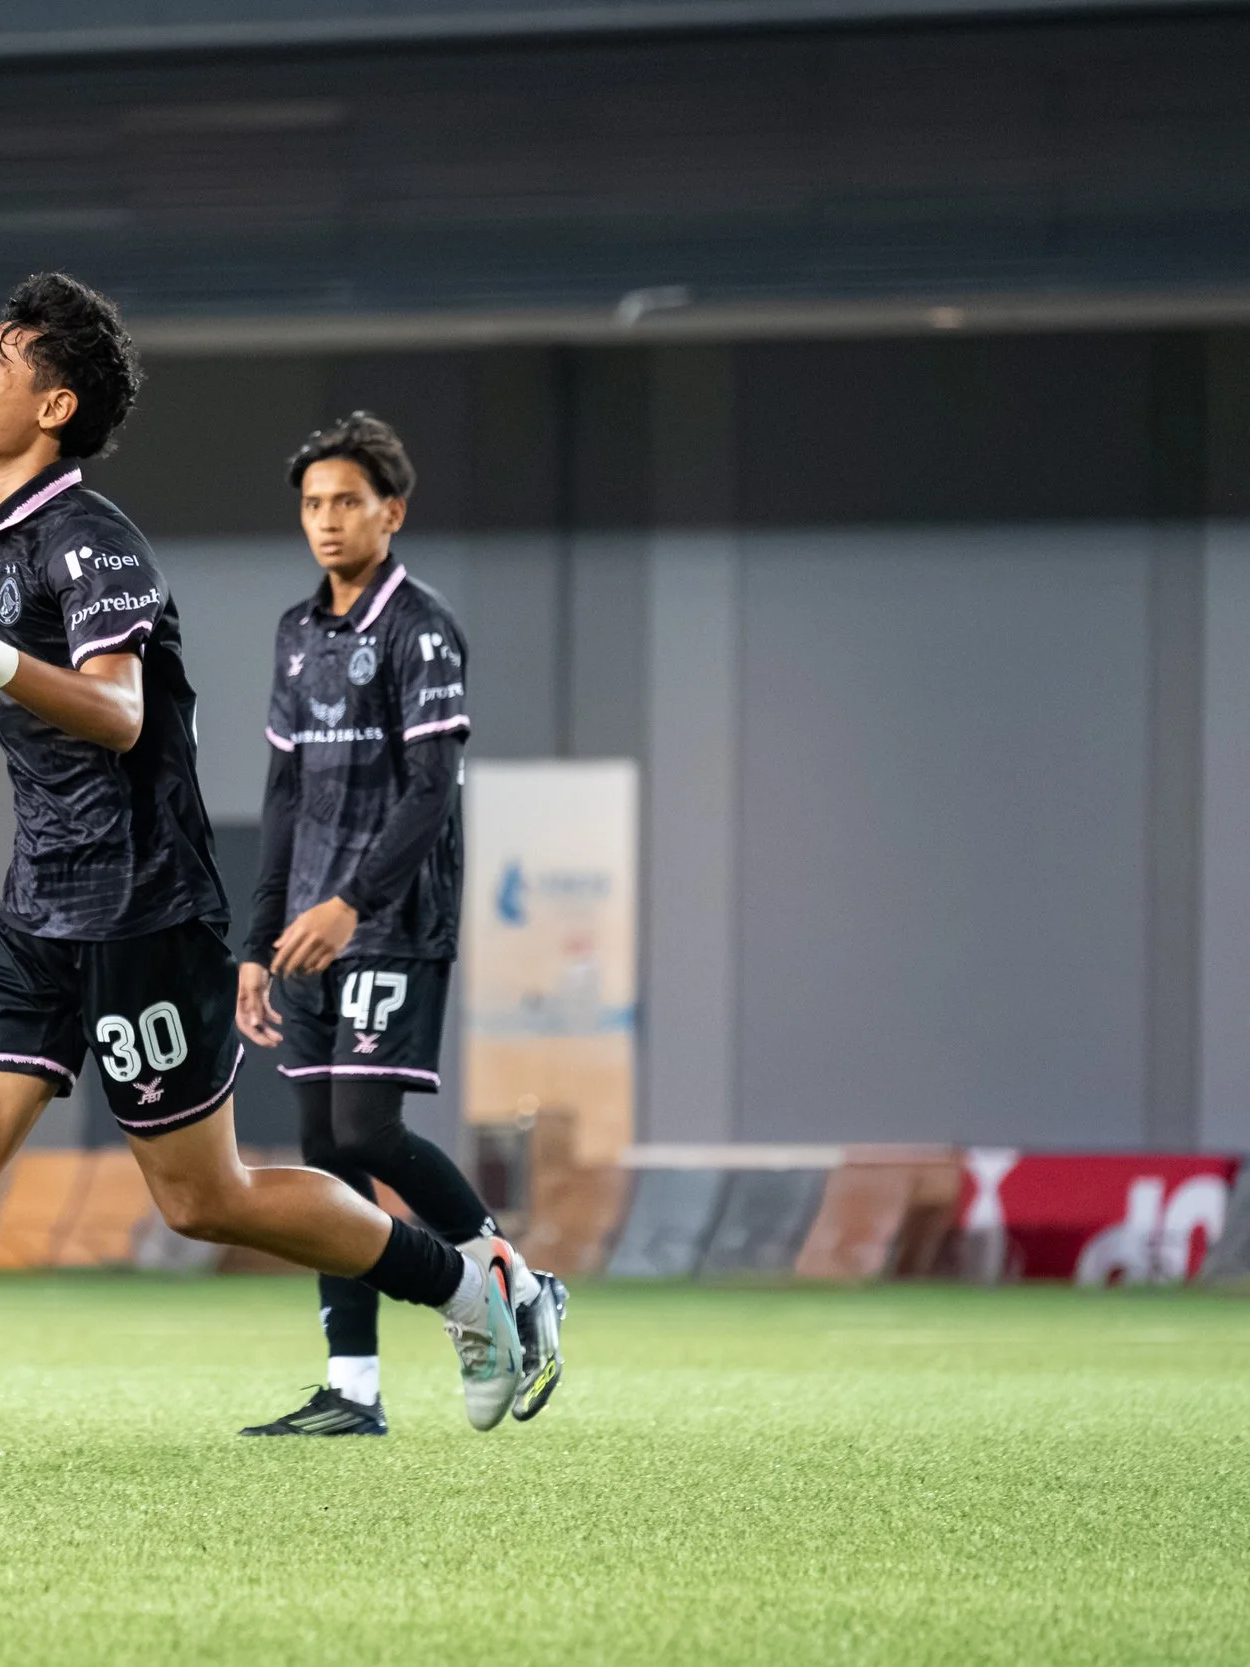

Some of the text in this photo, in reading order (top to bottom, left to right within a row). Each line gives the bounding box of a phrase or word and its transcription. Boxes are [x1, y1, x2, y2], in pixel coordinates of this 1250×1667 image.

[93, 553, 140, 571] rigel
[341, 970, 408, 1031] 47
[96, 1001, 188, 1082] 30
